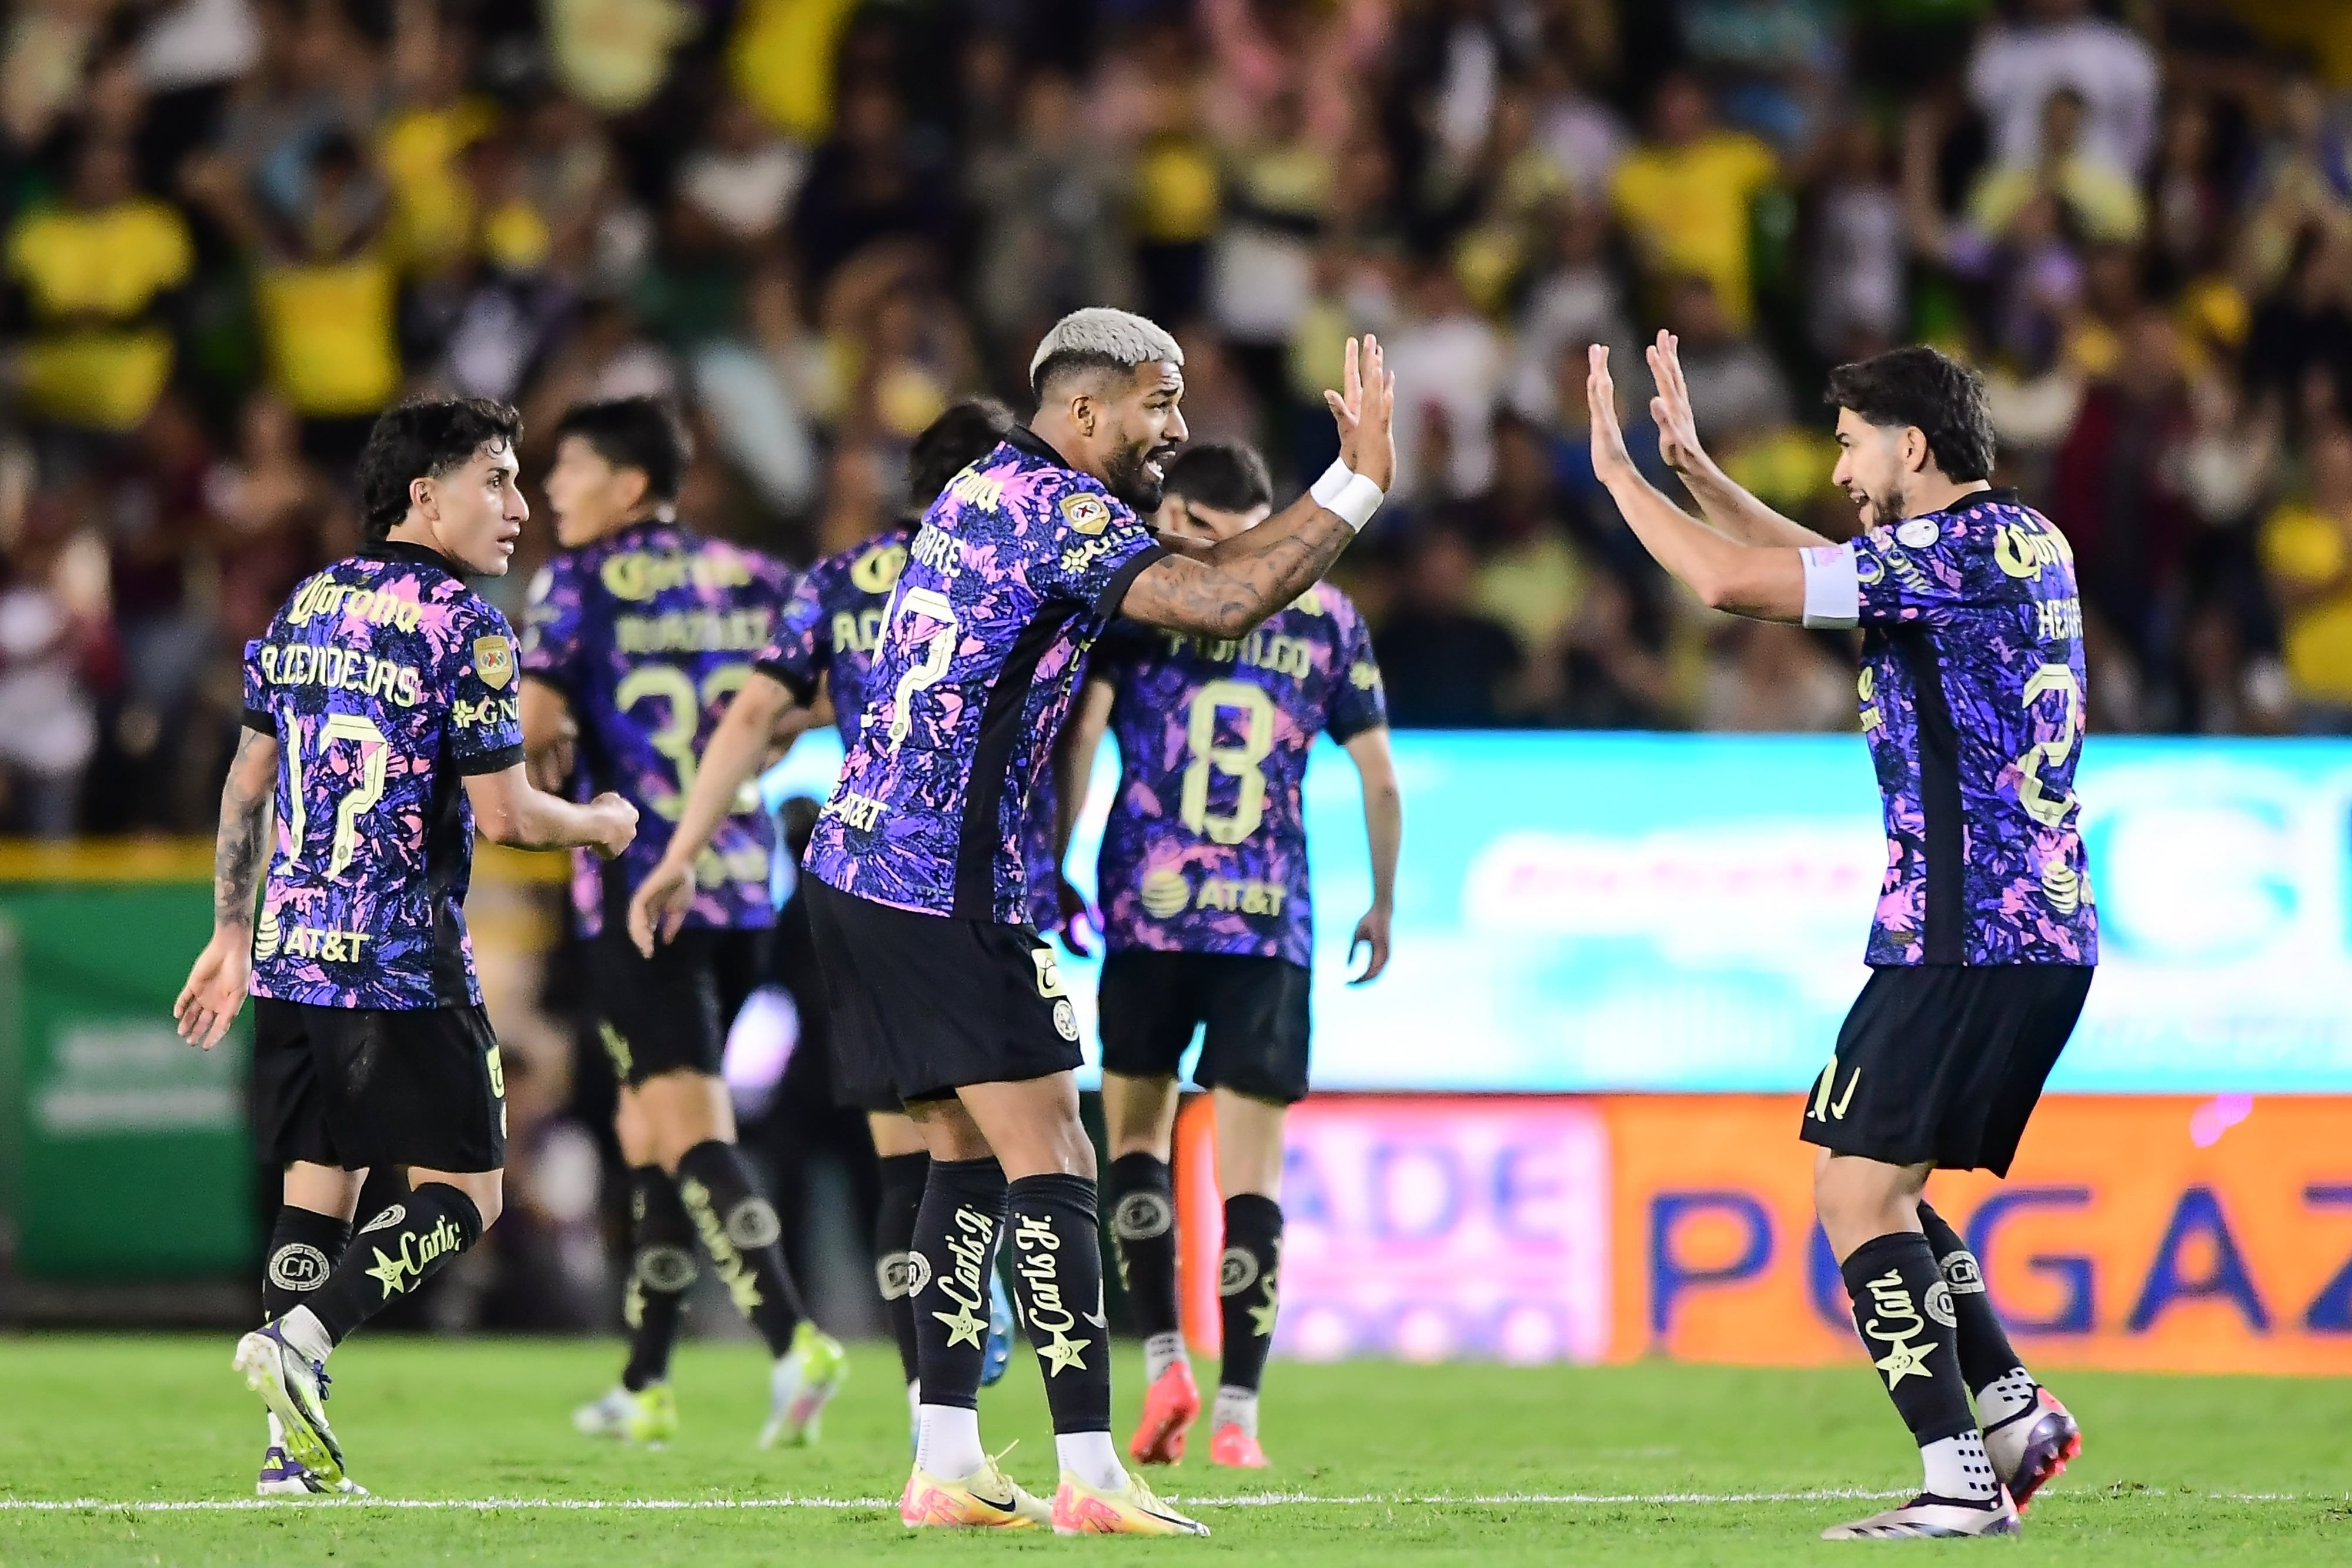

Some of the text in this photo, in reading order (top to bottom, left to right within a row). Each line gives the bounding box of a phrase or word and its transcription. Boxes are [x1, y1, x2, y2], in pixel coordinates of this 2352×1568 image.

[287, 571, 423, 634] Corona
[861, 579, 958, 754] 7
[273, 706, 389, 881] 17
[1181, 678, 1276, 845] 8
[838, 791, 892, 833] AT&T
[1196, 880, 1287, 917] AT&T
[283, 927, 371, 964] AT&T
[282, 1258, 314, 1279] CA
[937, 1235, 985, 1310] Carl's
[1017, 1251, 1075, 1332] Carl's
